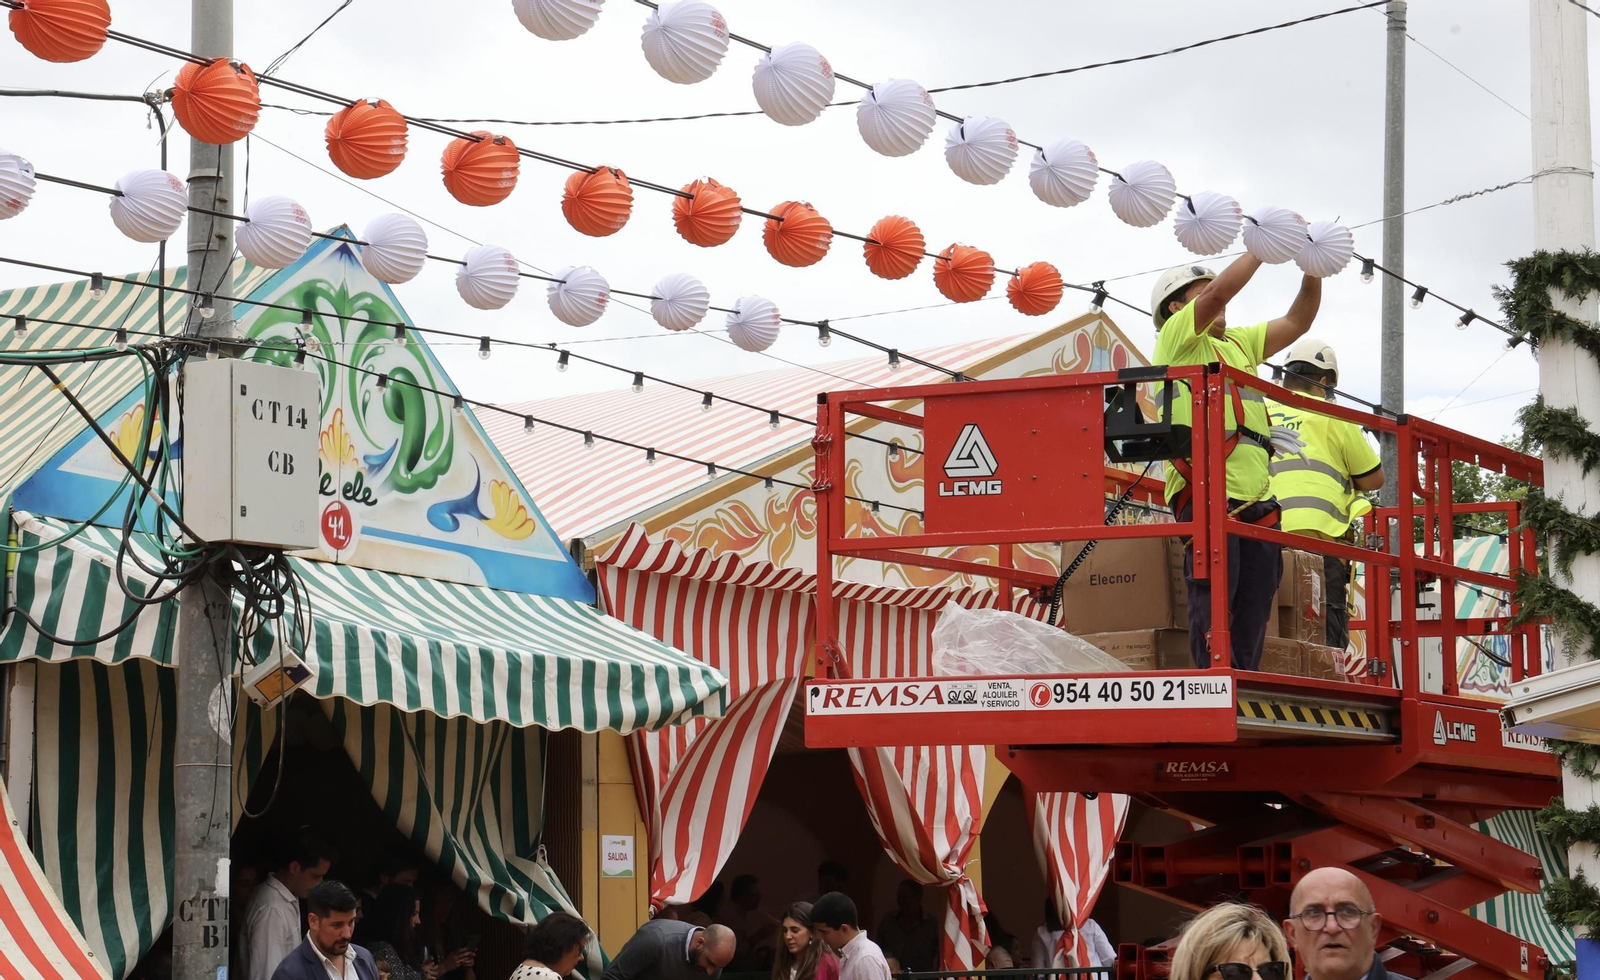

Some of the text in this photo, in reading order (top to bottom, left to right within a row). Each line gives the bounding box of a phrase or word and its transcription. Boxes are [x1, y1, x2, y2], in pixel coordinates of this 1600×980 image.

[268, 450, 295, 476] CB
[343, 471, 378, 506] ele
[939, 479, 1002, 497] LCMG
[328, 514, 346, 540] 41
[1089, 573, 1137, 586] Elecnor
[988, 682, 1012, 690] VENTA,
[1053, 679, 1186, 703] 954 40 50 21
[1187, 682, 1228, 695] SEVILLA
[822, 684, 945, 709] REMSA
[982, 691, 1018, 699] ALQUILER
[987, 700, 1020, 708] SERVICIO
[1446, 721, 1476, 742] LCMG
[1166, 761, 1229, 773] REMSA
[608, 852, 628, 861] SALIDA
